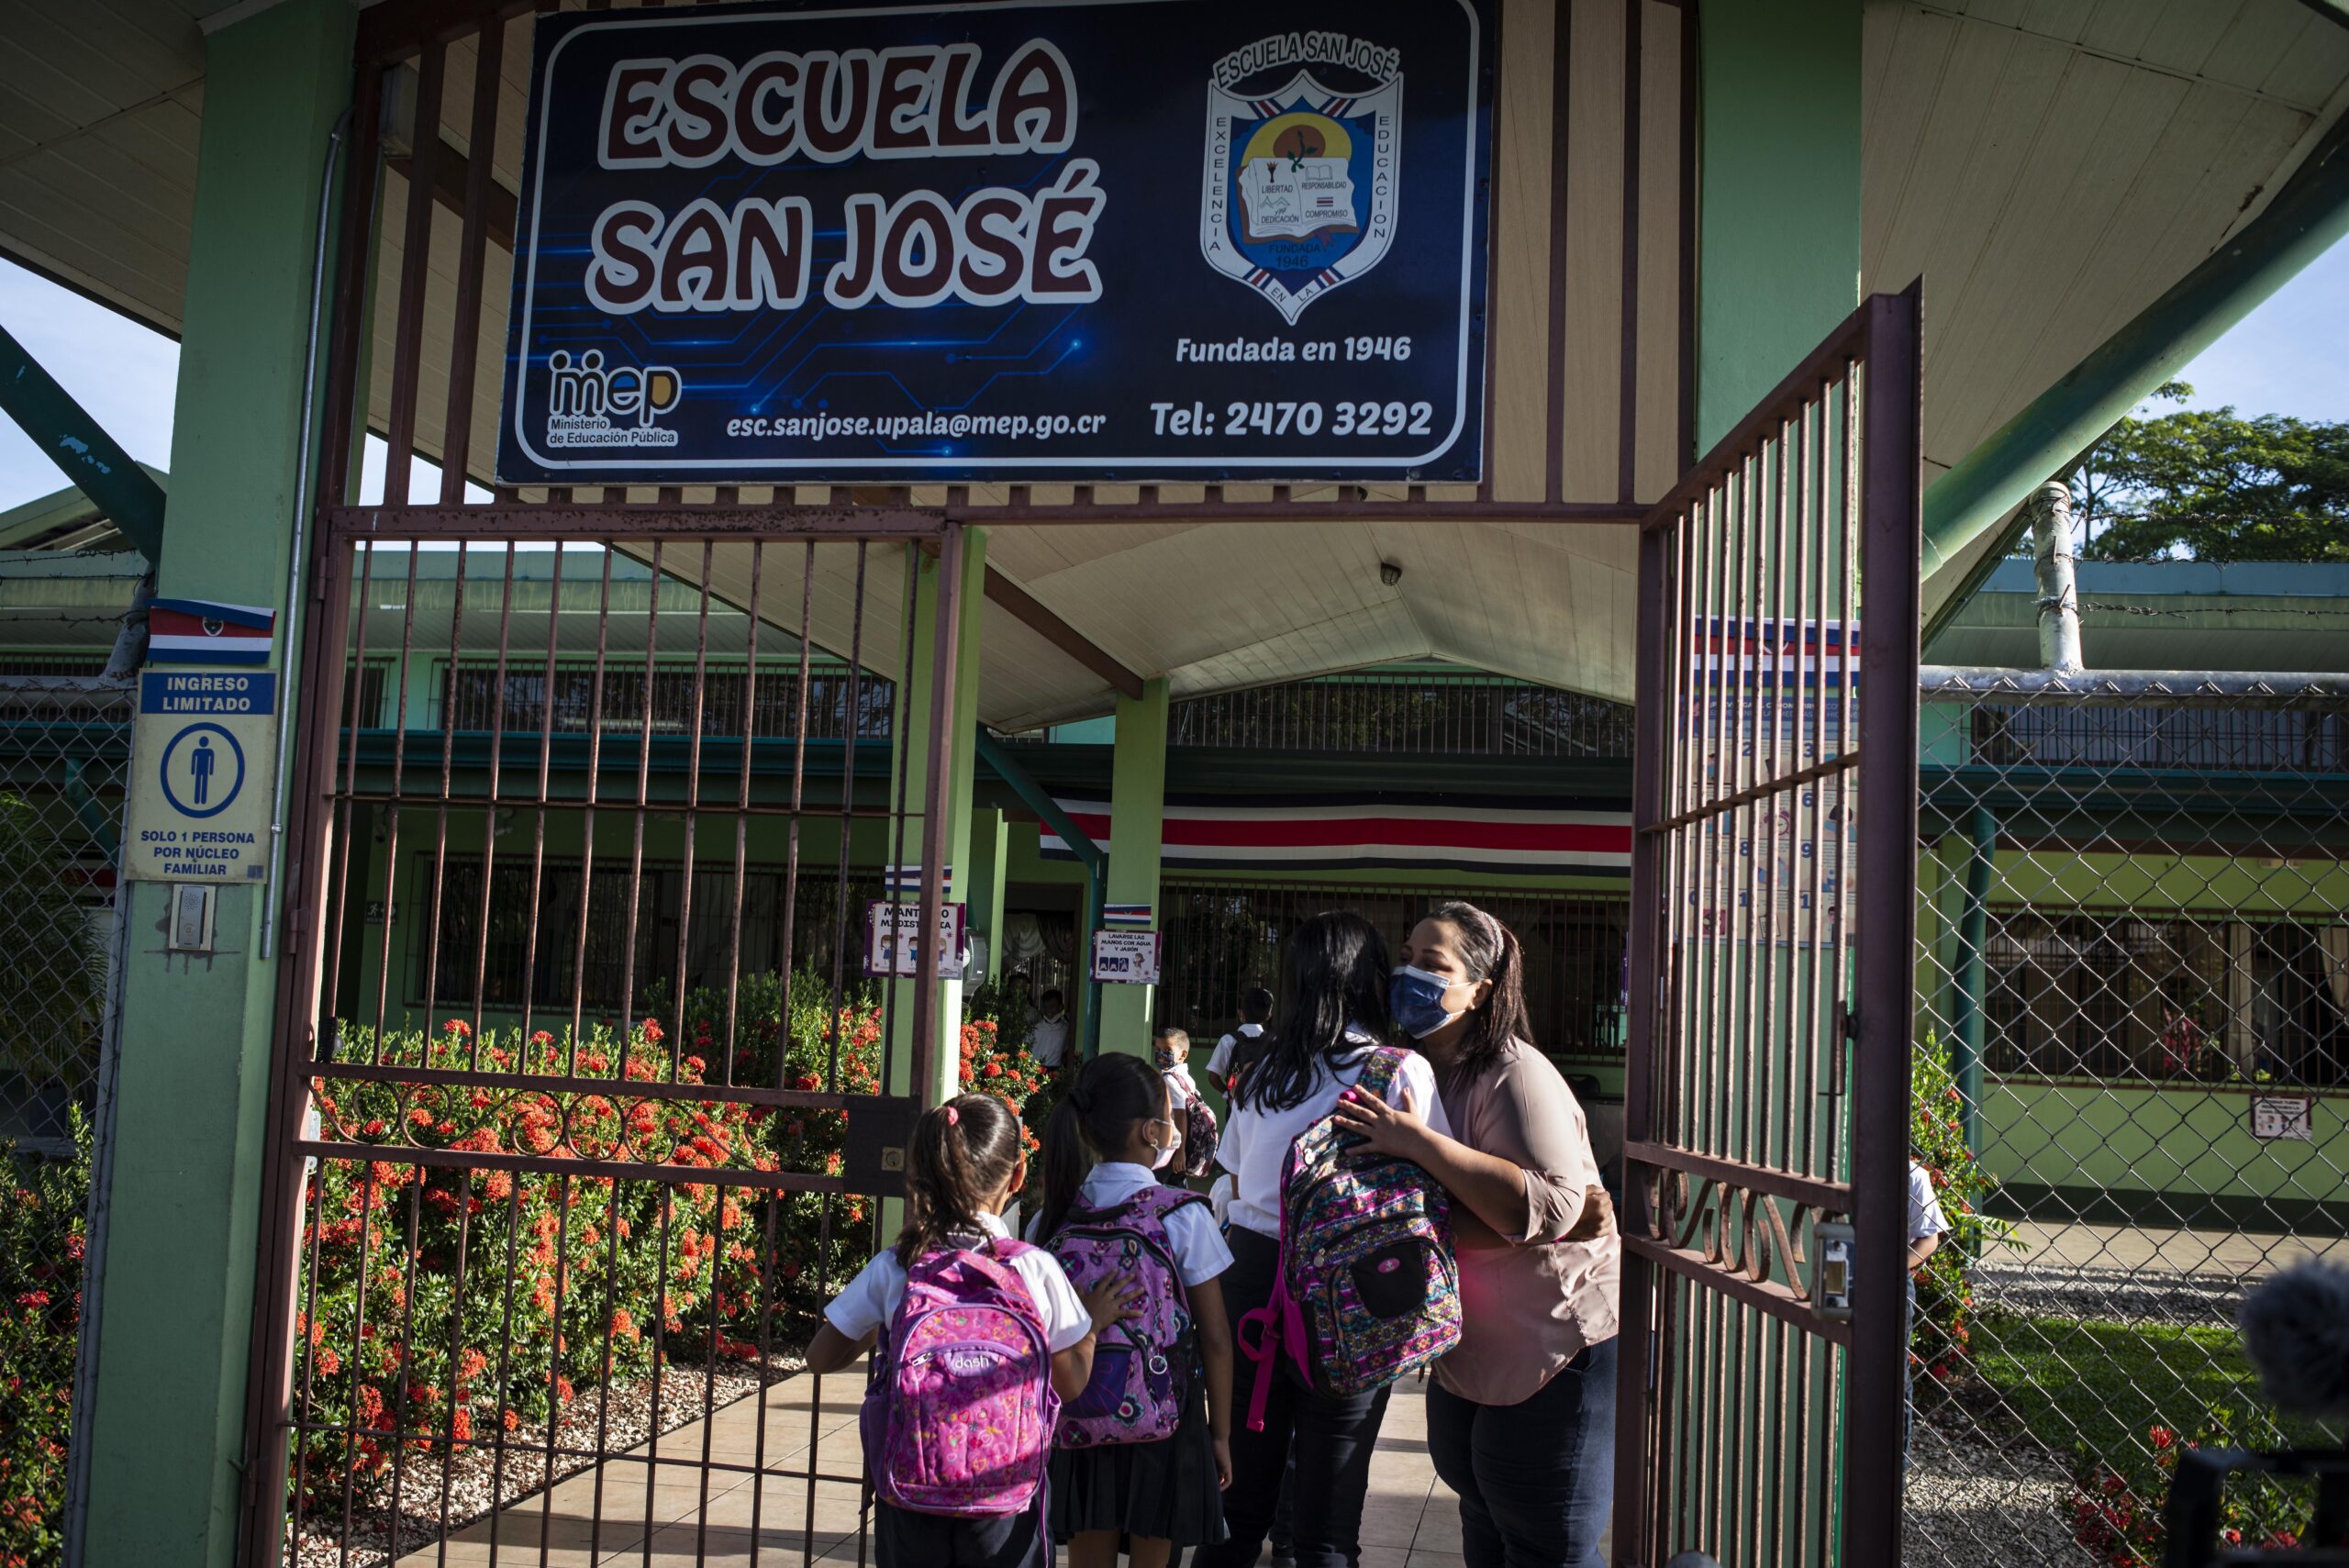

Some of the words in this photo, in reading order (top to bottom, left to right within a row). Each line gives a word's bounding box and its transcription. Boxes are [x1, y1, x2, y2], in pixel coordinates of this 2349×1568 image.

[1214, 35, 1300, 89] ESCUELA
[1305, 35, 1343, 61] SAN
[1347, 41, 1396, 83] JOSÉ
[599, 39, 1077, 169] ESCUELA
[1208, 117, 1227, 251] EXCELENCIA
[1374, 116, 1389, 239] EDUCACION
[1261, 184, 1294, 194] LIBERTAD
[1301, 181, 1347, 190] RESPONSABILIDAD
[1261, 214, 1299, 224] DEDICACIÓN
[1305, 209, 1348, 218] COMPROMISO
[586, 198, 812, 313] SAN
[826, 160, 1106, 309] JOSÉ
[1269, 243, 1321, 253] FUNDADA
[1276, 255, 1308, 267] 1946
[1271, 286, 1286, 303] EN
[1297, 287, 1313, 302] LA
[1175, 338, 1295, 362] Fundada
[1301, 342, 1336, 361] en
[1343, 336, 1411, 361] 1946
[551, 418, 607, 430] Ministerio
[726, 411, 1106, 440] esc.sanjose.upala@mep.go.cr
[1150, 401, 1215, 436] Tel:
[1224, 401, 1322, 436] 2470
[1331, 401, 1432, 436] 3292
[551, 432, 564, 444] de
[567, 431, 628, 443] Educación
[631, 431, 674, 443] Pública
[167, 676, 249, 692] INGRESO
[162, 696, 250, 712] LIMITADO
[140, 829, 176, 843] SOLO
[182, 830, 187, 843] 1
[192, 830, 255, 844] PERSONA
[153, 846, 182, 859] POR
[185, 844, 239, 860] NÚCLEO
[163, 862, 227, 875] FAMILIAR
[884, 907, 950, 918] MANTO
[954, 1355, 989, 1368] dash
